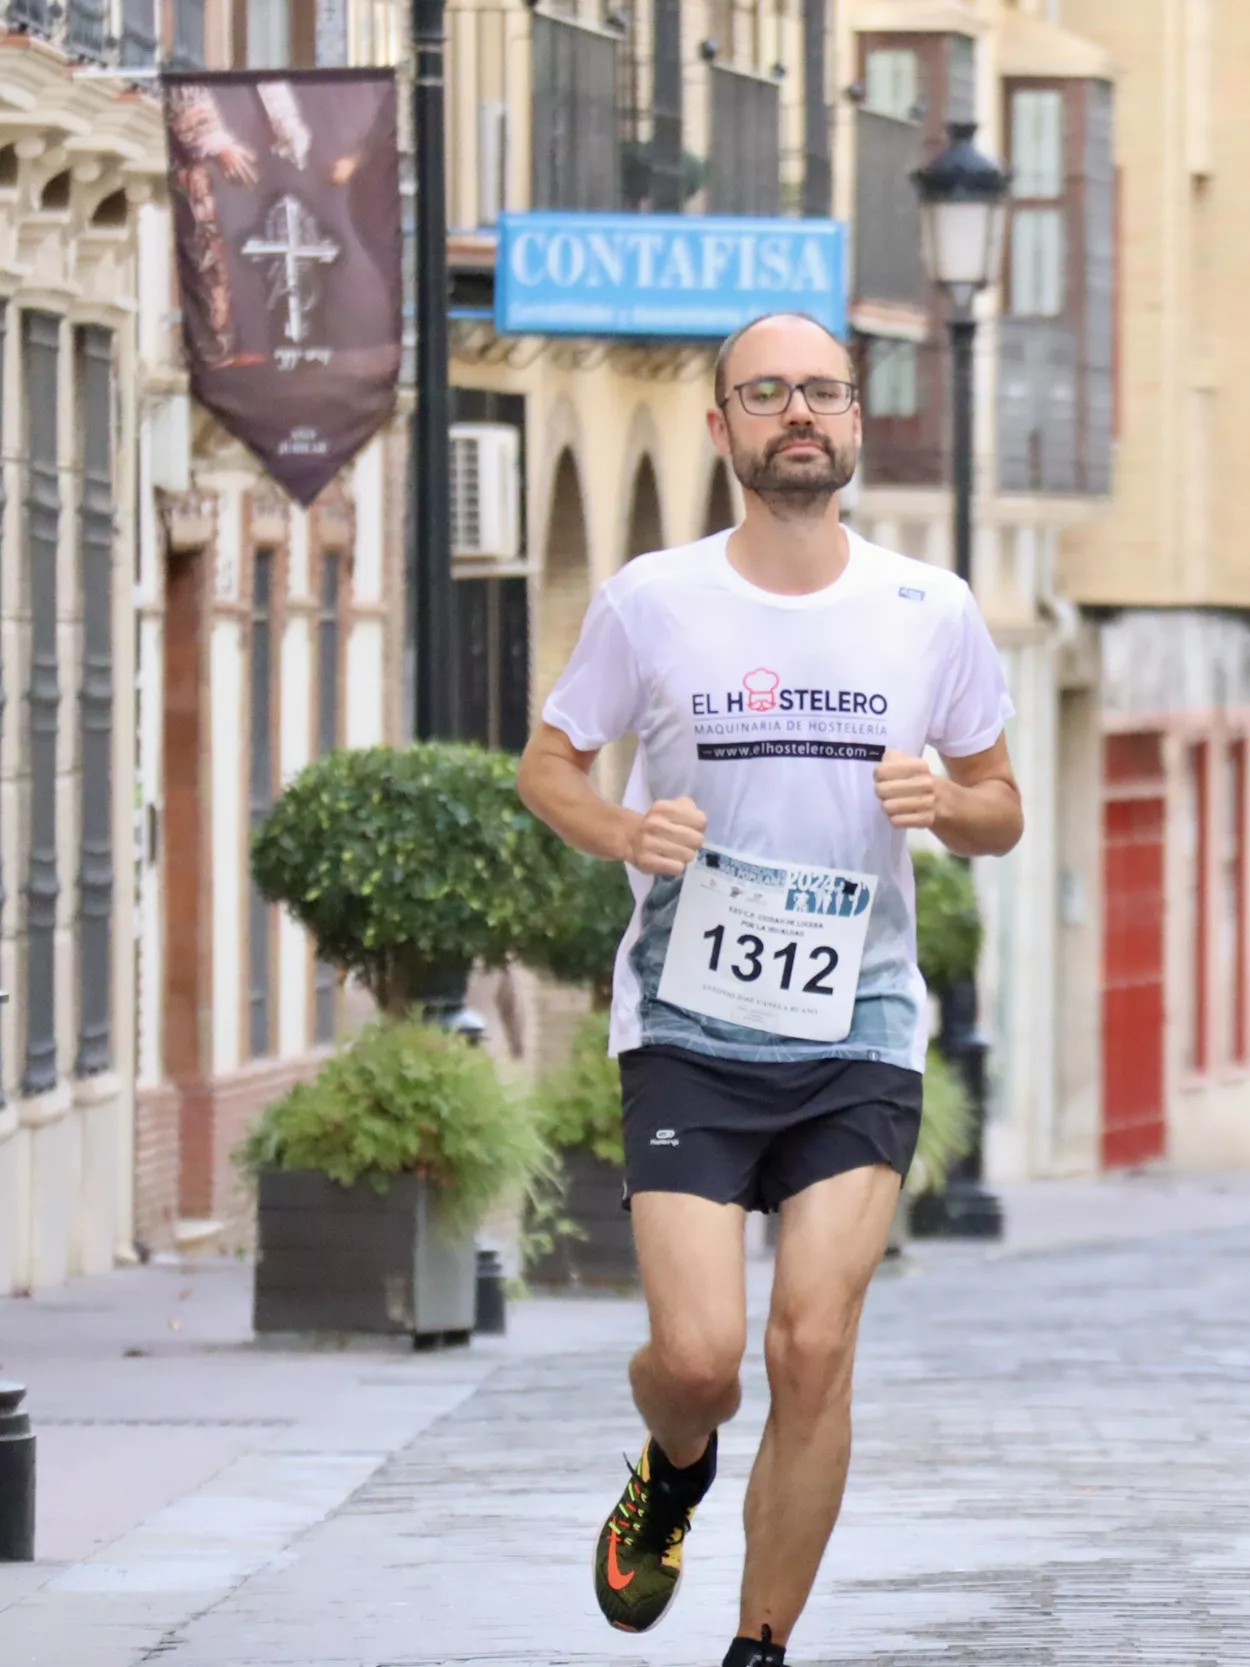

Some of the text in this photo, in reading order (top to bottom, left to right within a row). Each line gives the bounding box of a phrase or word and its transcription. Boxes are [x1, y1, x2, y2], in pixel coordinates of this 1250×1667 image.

[509, 230, 833, 292] CONTAFISA
[692, 693, 719, 715] EL
[694, 720, 888, 736] MAQUINARIA DE HOSTELERÍA
[713, 741, 868, 758] www.elhostelero.com
[788, 870, 832, 892] 2024
[741, 920, 754, 929] POR
[703, 924, 839, 996] 1312
